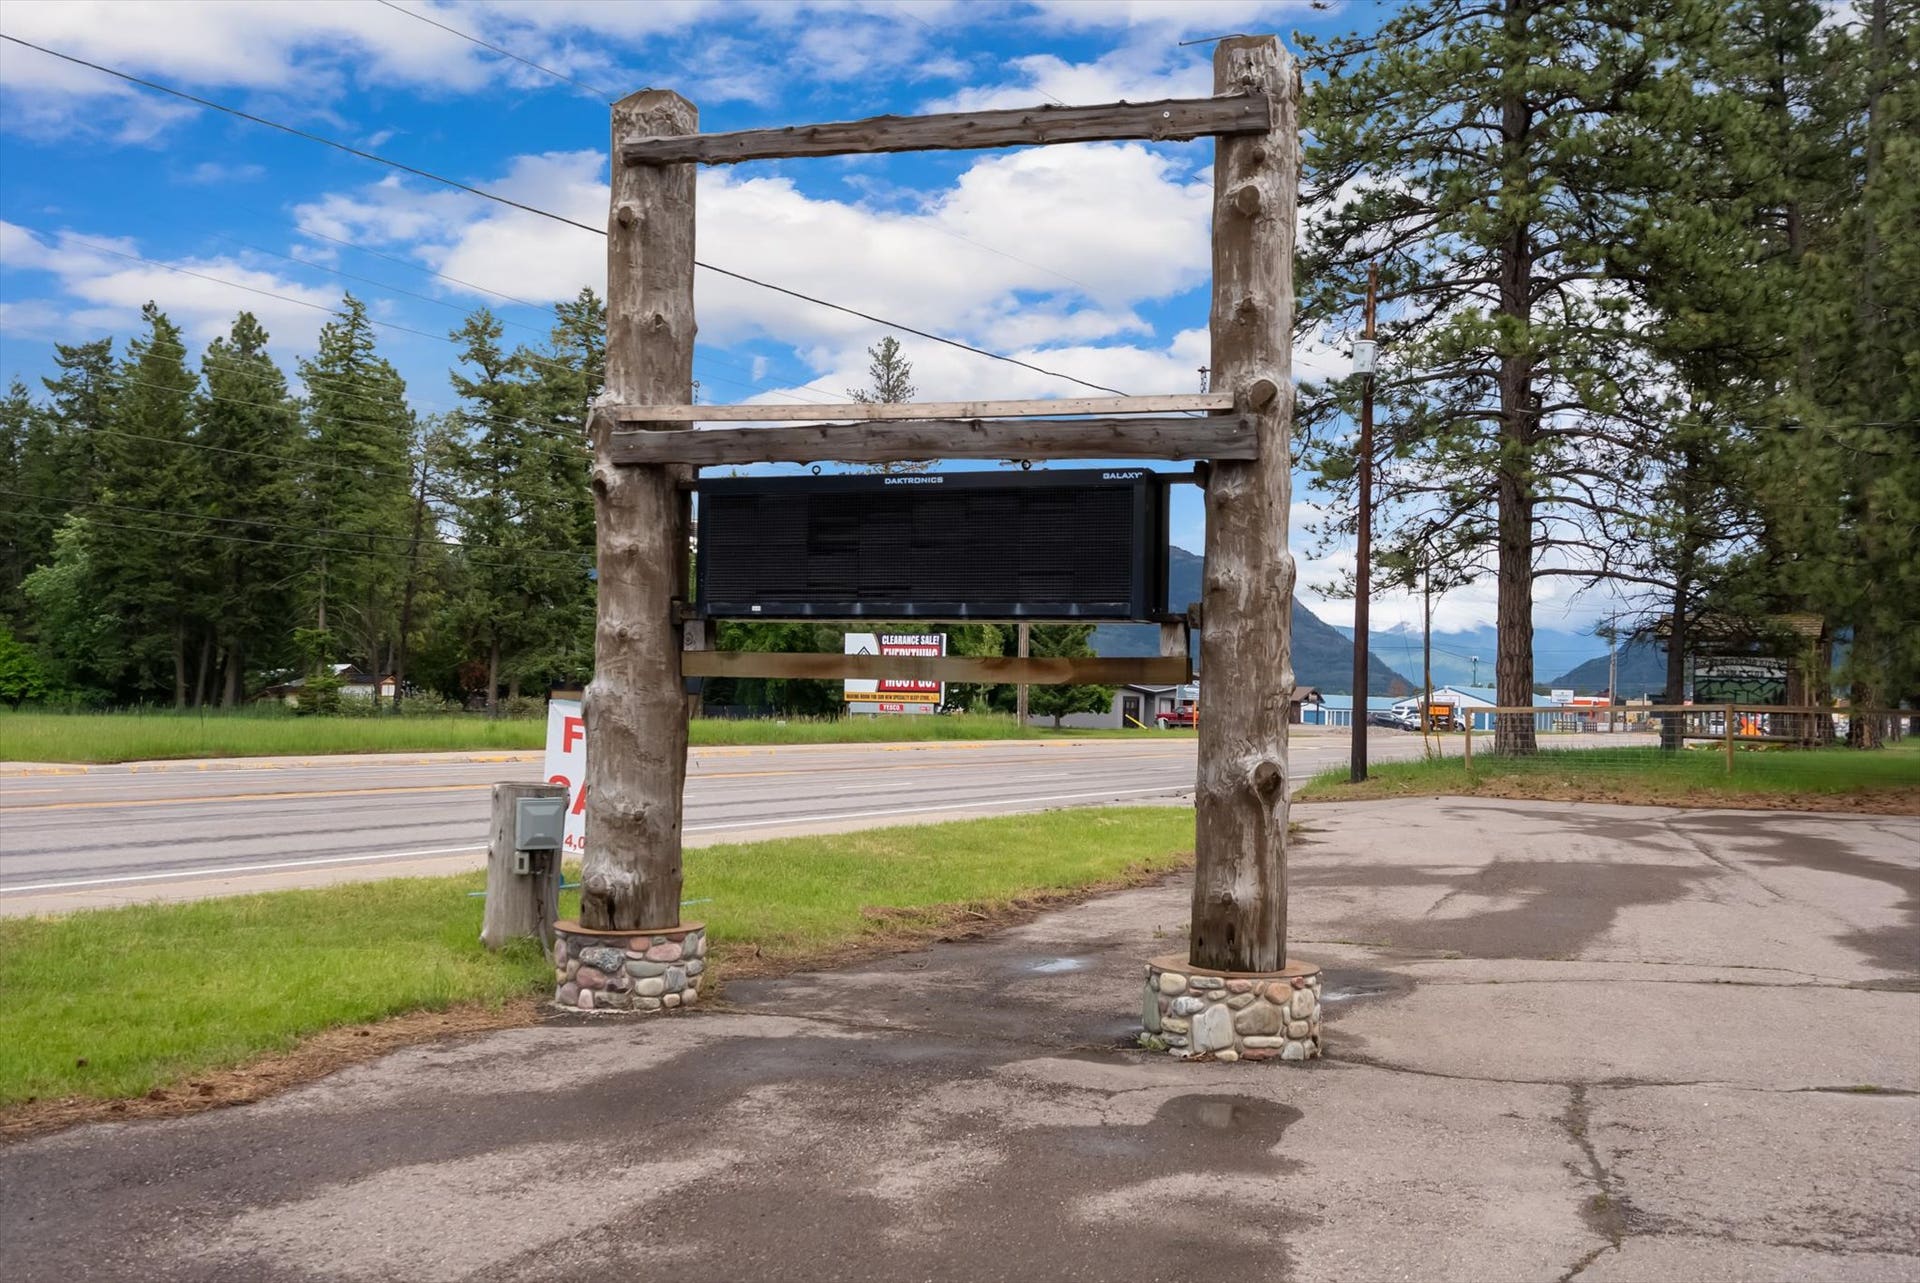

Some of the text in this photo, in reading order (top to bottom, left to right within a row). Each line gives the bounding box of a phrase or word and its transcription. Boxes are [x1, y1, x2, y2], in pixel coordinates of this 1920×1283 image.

[884, 476, 944, 485] DAKTRONICS
[1102, 472, 1141, 480] GALAXY
[881, 635, 940, 645] CLEARANCE SALE!
